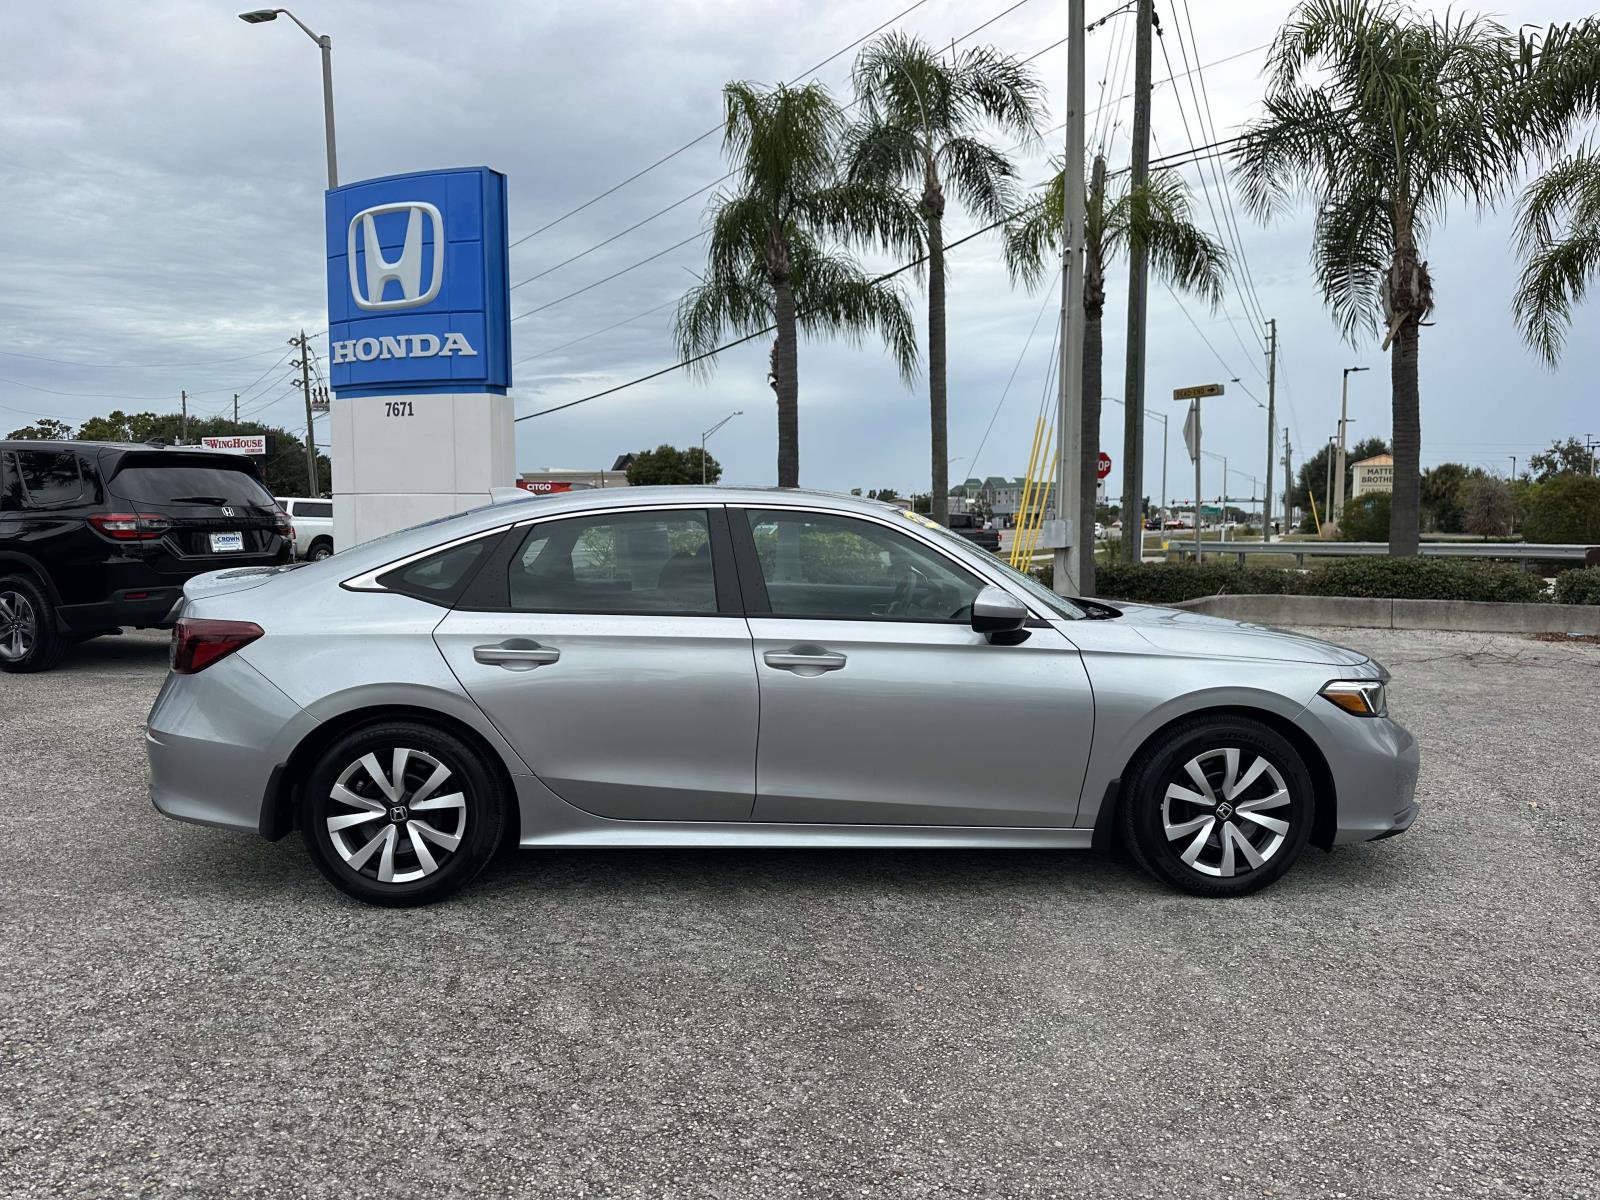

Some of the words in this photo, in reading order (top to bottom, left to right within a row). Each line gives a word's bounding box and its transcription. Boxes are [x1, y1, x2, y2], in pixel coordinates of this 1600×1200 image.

[332, 333, 478, 364] HONDA
[385, 402, 414, 417] 7671
[526, 483, 552, 491] CITGO
